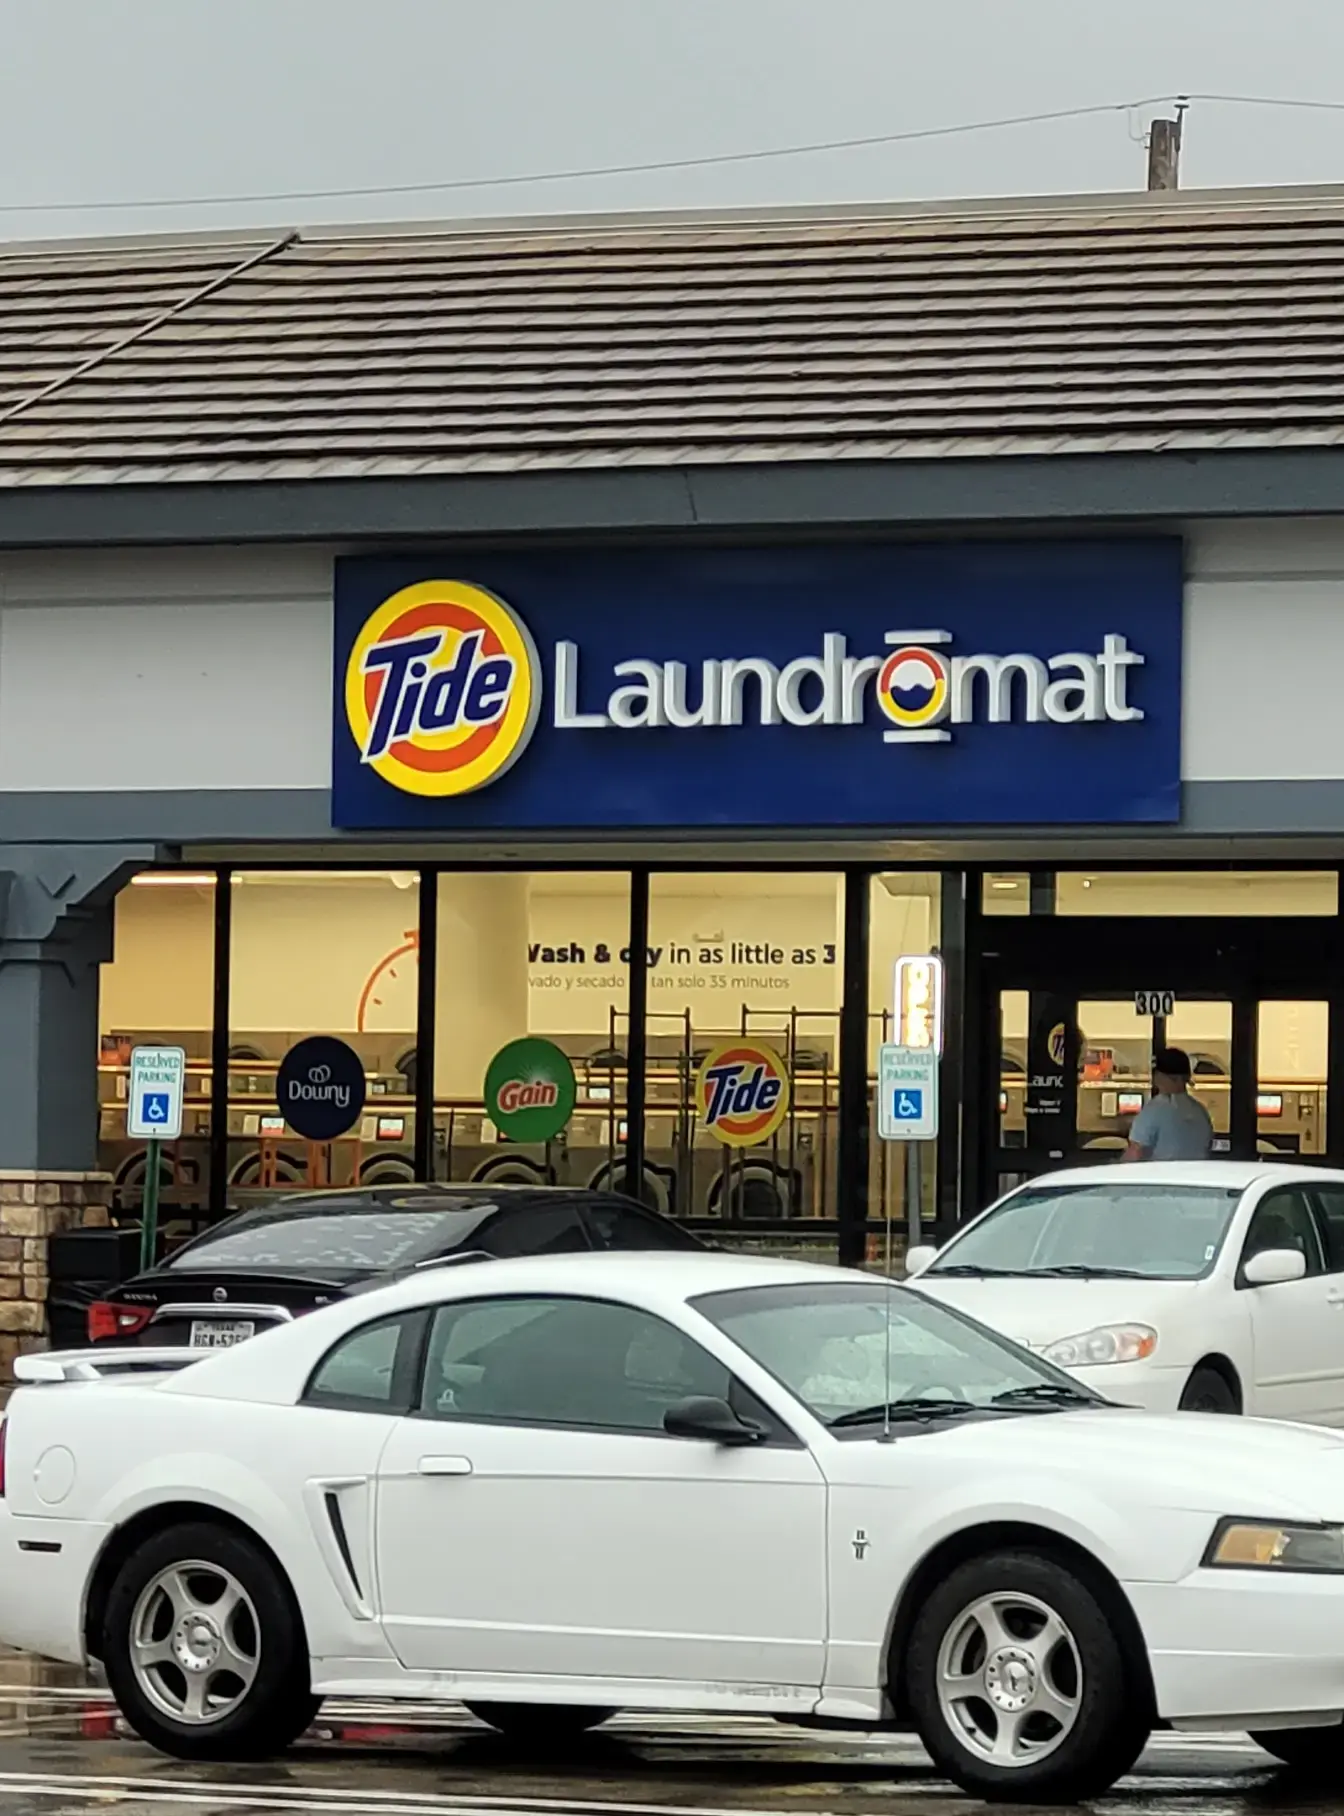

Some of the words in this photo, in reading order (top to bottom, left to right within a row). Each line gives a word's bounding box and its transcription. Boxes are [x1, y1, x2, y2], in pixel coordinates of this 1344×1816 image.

[360, 627, 514, 764] Tide
[555, 630, 1145, 737] Laundromat
[594, 943, 611, 964] &
[670, 943, 691, 965] in
[699, 947, 724, 965] as
[731, 942, 785, 965] little
[792, 947, 817, 965] as
[564, 976, 575, 990] y
[576, 974, 625, 988] secado
[651, 975, 674, 988] tan
[678, 975, 706, 988] solo
[709, 975, 727, 988] 35
[731, 975, 790, 989] minutos
[1135, 991, 1175, 1016] 300
[135, 1055, 181, 1069] RESERVED
[884, 1053, 934, 1066] RESERVED
[137, 1070, 177, 1084] PARKING
[886, 1068, 929, 1082] PARKING
[288, 1079, 351, 1108] Downy
[497, 1079, 559, 1114] Gain
[705, 1063, 782, 1127] Tide
